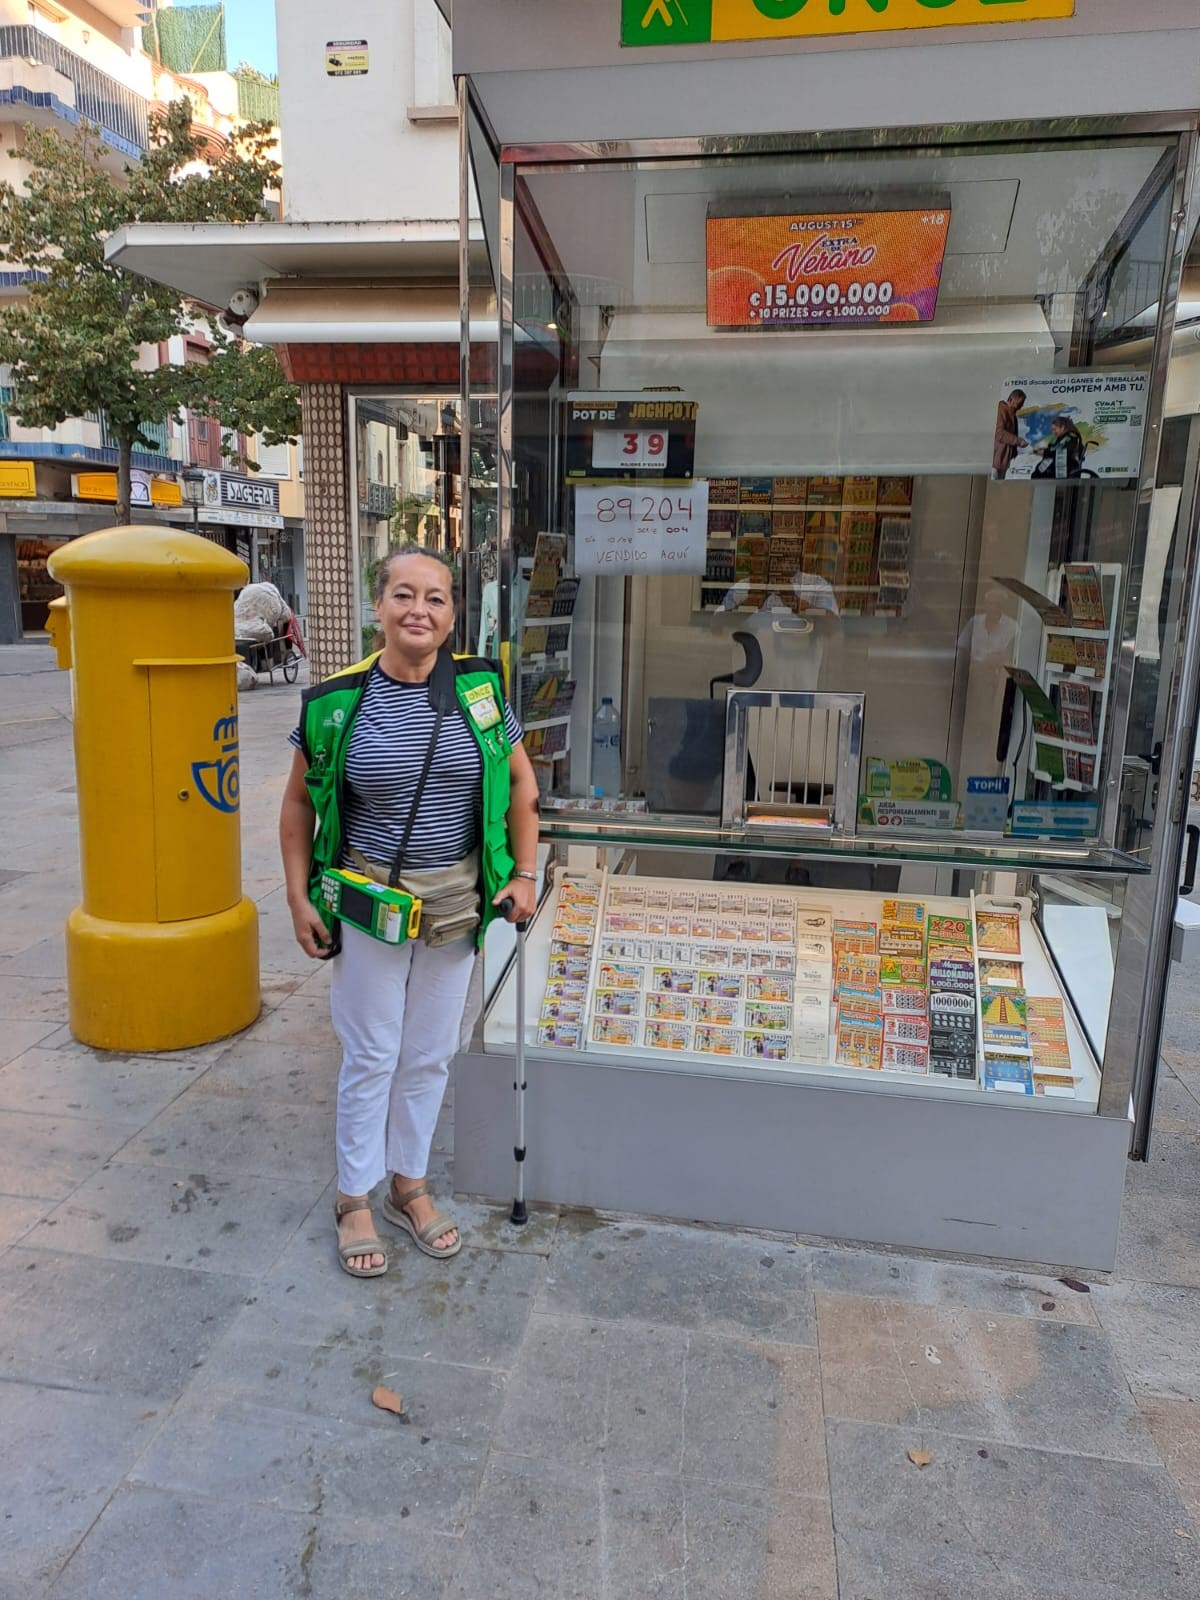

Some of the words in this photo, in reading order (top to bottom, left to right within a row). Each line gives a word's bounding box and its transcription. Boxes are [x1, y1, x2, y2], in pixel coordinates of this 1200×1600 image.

[790, 220, 837, 231] AUGUST
[822, 237, 857, 247] EXTRA
[773, 234, 876, 281] Verano
[759, 308, 770, 319] 10
[772, 306, 809, 318] PRIZES
[1051, 384, 1102, 394] COMPTEM
[1104, 383, 1127, 392] AMB
[1130, 383, 1145, 391] TU.
[572, 410, 597, 420] POT
[600, 410, 616, 420] DE
[596, 497, 692, 522] 89204
[597, 550, 648, 563] VENDIDO
[930, 968, 974, 979] MILLONARIO
